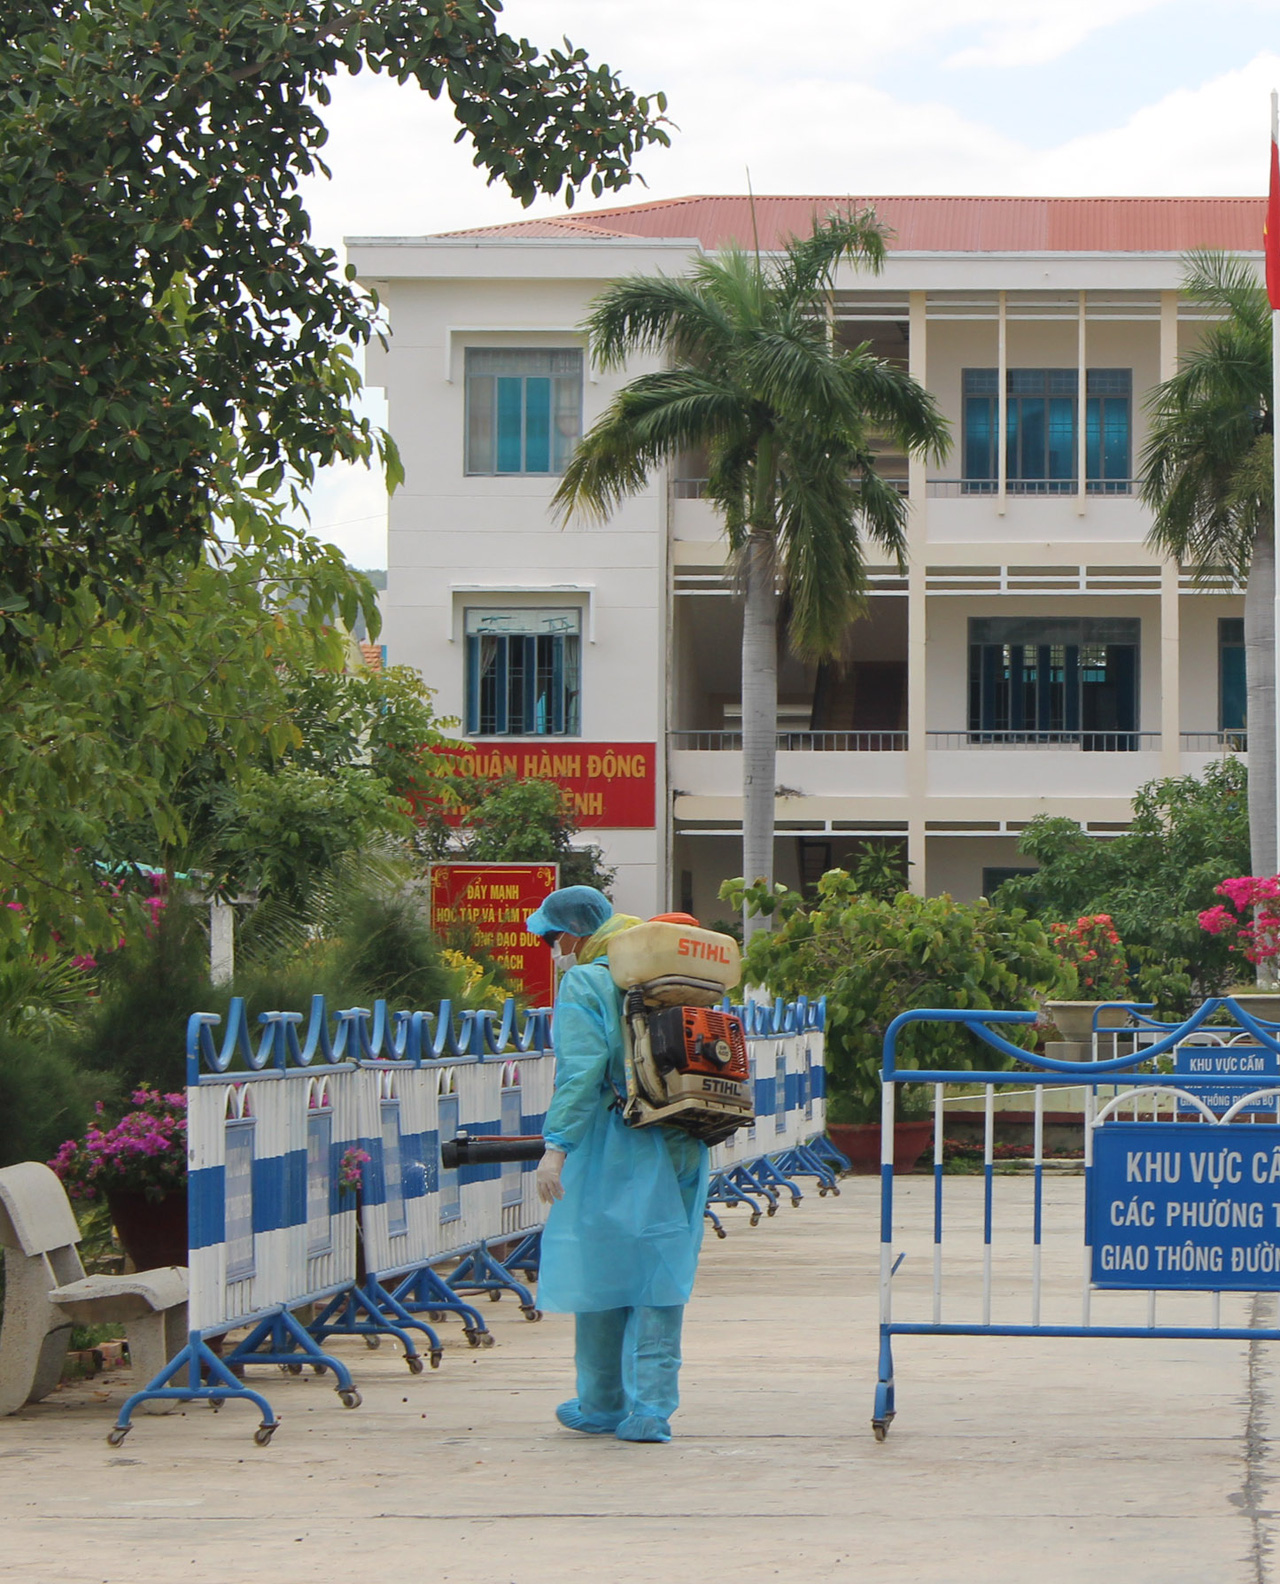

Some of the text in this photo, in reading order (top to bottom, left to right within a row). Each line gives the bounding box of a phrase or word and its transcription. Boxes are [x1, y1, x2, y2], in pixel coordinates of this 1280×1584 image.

[524, 749, 581, 777] HÀNH
[586, 749, 645, 782] ĐỘNG
[467, 877, 519, 902] ĐẨY MẠNH
[437, 908, 456, 925] HỌC
[482, 904, 495, 922] VÀ
[677, 938, 731, 964] STIHL
[1190, 1054, 1264, 1073] KHU VỰC CẤM
[702, 1078, 741, 1097] STIHL
[1126, 1151, 1181, 1183] KHU
[1189, 1148, 1242, 1189] VỰC
[1110, 1196, 1155, 1226] CÁC
[1166, 1199, 1263, 1228] PHƯƠNG
[1101, 1244, 1149, 1270] GIAO
[1155, 1240, 1222, 1272] THÔNG
